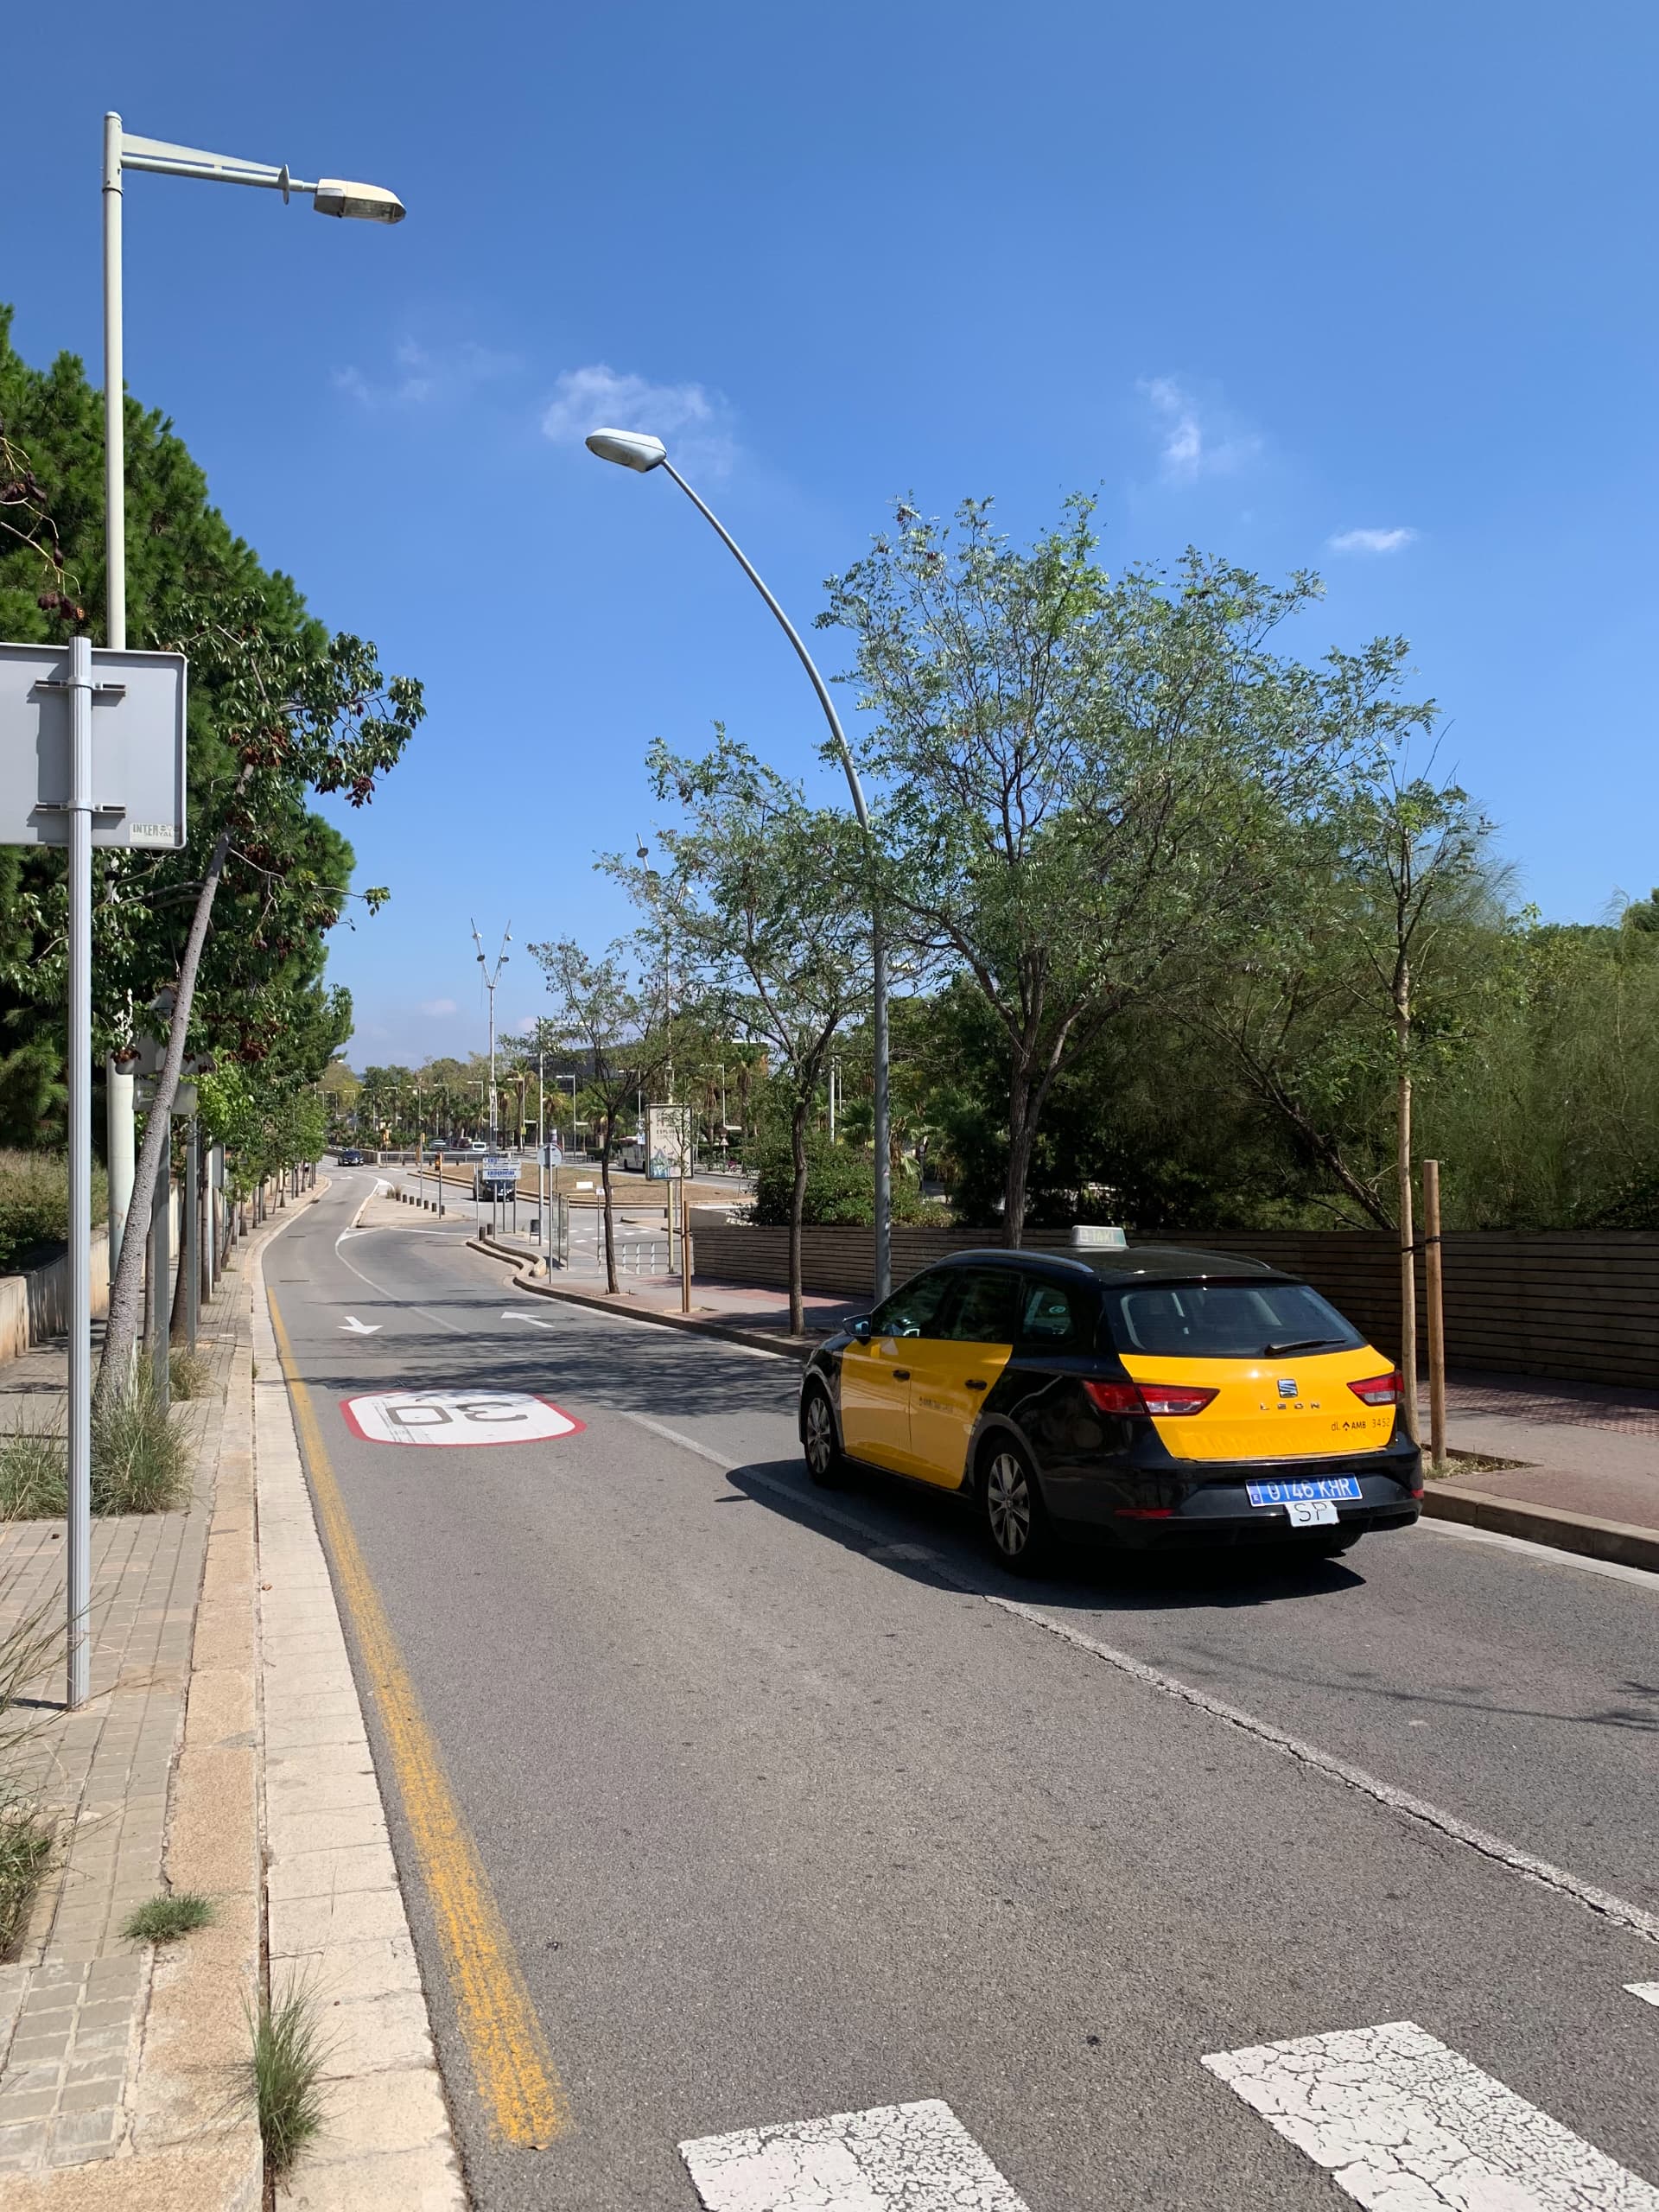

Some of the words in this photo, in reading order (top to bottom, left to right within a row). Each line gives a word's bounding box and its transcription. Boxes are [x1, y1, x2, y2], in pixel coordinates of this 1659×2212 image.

[132, 823, 158, 836] INTER
[385, 1402, 528, 1427] 30
[1351, 1421, 1367, 1430] AMB
[1267, 1478, 1314, 1501] 0146
[1317, 1477, 1353, 1497] KHR
[1294, 1501, 1327, 1522] SP
